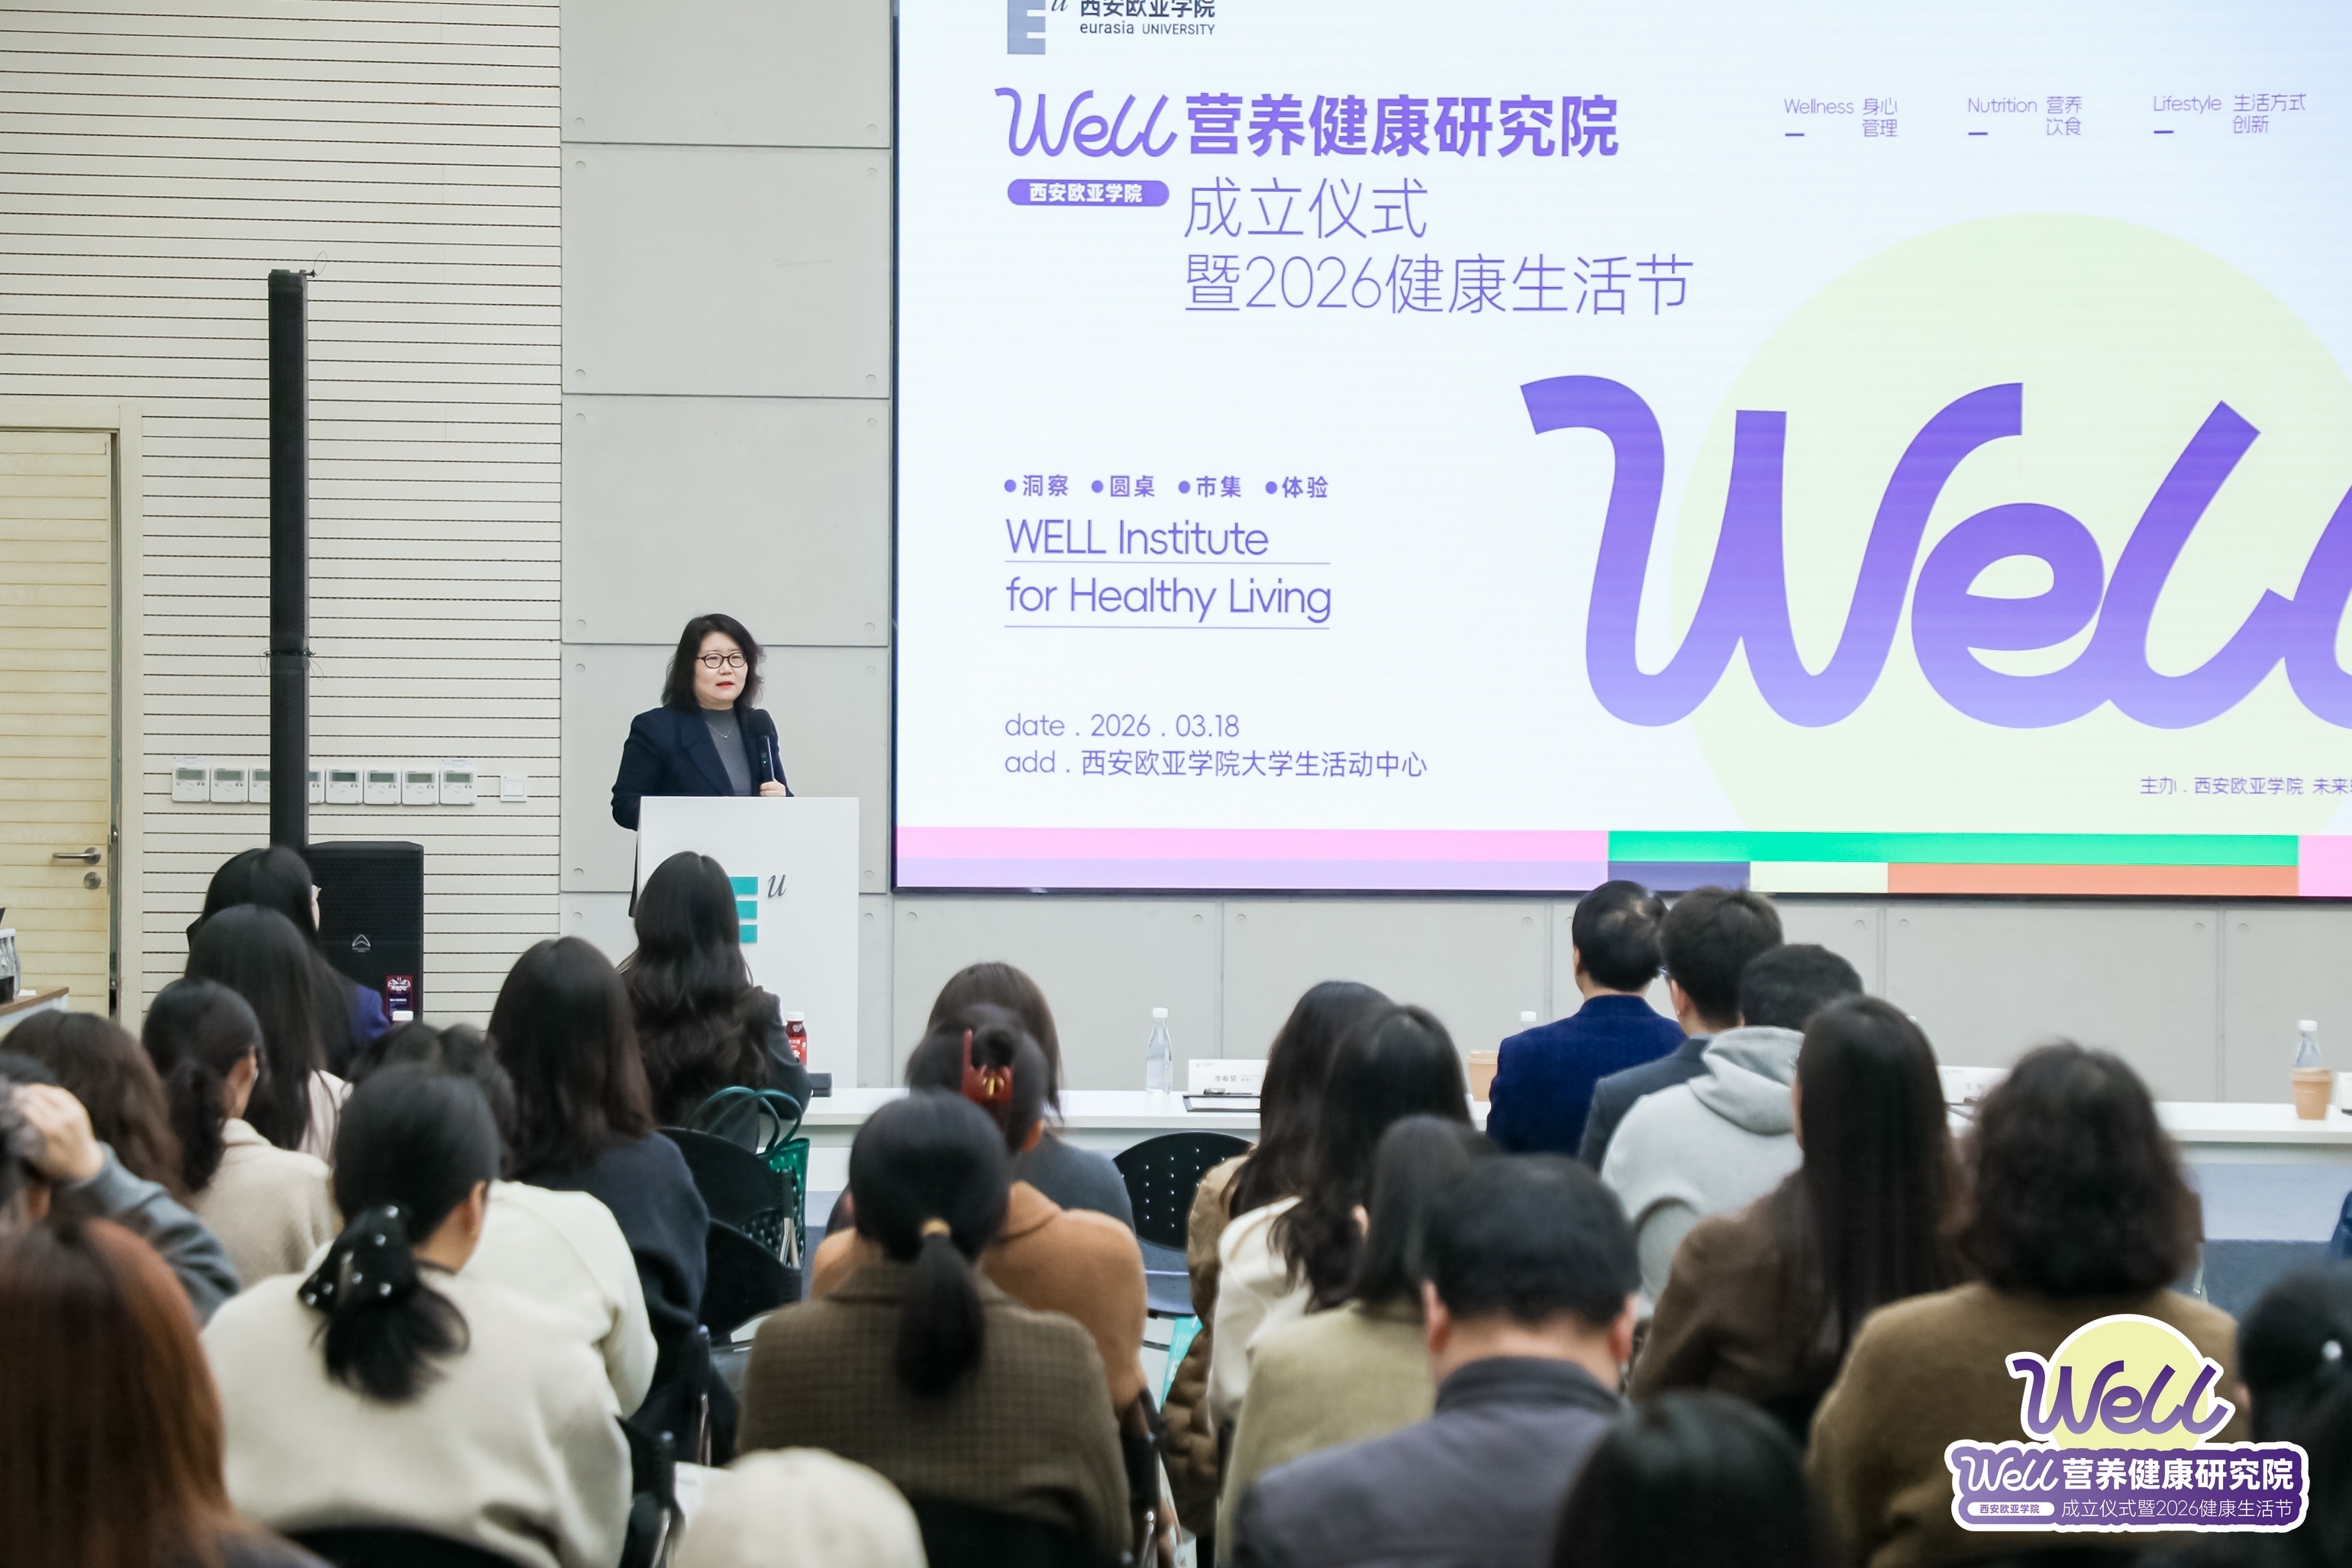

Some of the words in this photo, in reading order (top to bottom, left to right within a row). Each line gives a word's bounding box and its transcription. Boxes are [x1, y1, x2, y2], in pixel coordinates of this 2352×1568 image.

[1080, 0, 1215, 18] 西安欧亚学院
[1080, 21, 1134, 34] eurasia
[1143, 24, 1215, 34] UNIVERSITY
[1785, 98, 1854, 114] Wellness
[1863, 98, 1897, 115] 身心
[1969, 97, 2037, 112] Nutrition
[2047, 96, 2082, 114] 营养
[2154, 95, 2221, 115] Lifestyle
[2234, 93, 2306, 111] 生活方式
[995, 88, 1178, 157] Well
[1186, 92, 1618, 157] 营养健康研究院
[1863, 119, 1897, 137] 管理
[2047, 117, 2081, 135] 饮食
[2233, 115, 2269, 134] 创新
[1030, 182, 1142, 202] 西安欧亚学院
[1184, 176, 1428, 238] 成立仪式
[1186, 253, 1693, 315] 暨2026健康生活节
[1023, 474, 1068, 496] 洞察
[1111, 475, 1154, 497] 圆桌
[1196, 476, 1241, 498] 市集
[1282, 476, 1328, 498] 体验
[1006, 519, 1106, 553] WELL
[1120, 520, 1269, 555] Institute
[1006, 576, 1057, 611] for
[1071, 578, 1217, 623] Healthy
[1231, 578, 1331, 623] Living
[1005, 713, 1064, 736] date
[1092, 714, 1150, 737] 2026
[1176, 715, 1239, 737] 03.18
[1005, 750, 1054, 773] add
[1082, 750, 1427, 777] 西安欧亚学院大学生活动中心
[2141, 776, 2176, 794] 主办
[2195, 777, 2303, 795] 西安欧亚学院
[2313, 778, 2352, 794] 未来
